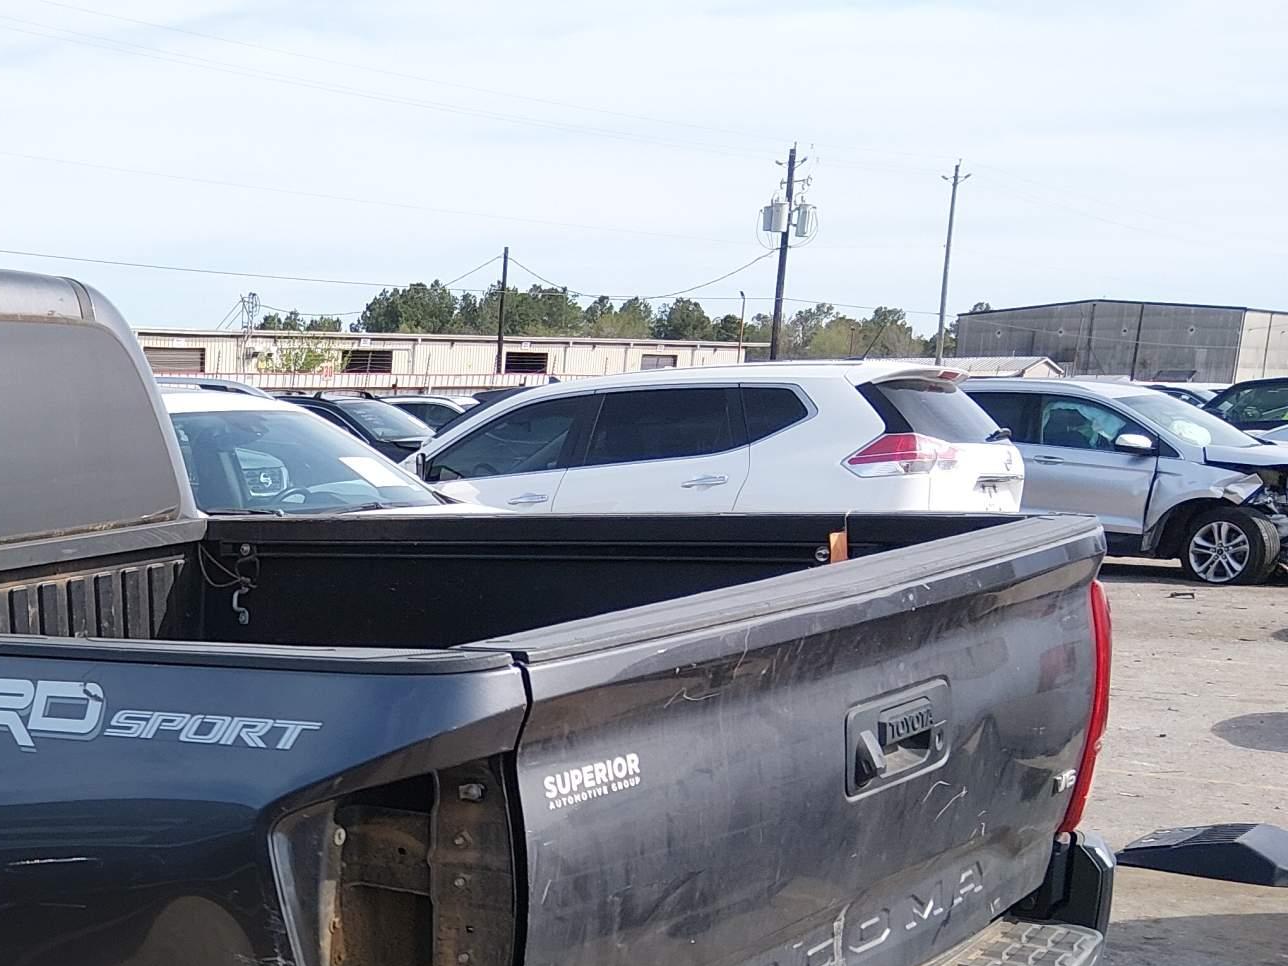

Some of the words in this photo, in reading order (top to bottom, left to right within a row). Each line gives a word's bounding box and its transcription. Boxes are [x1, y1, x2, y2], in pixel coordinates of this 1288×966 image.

[104, 709, 323, 751] SPORT
[888, 708, 934, 740] TOYOTA
[544, 753, 641, 799] SUPERIOR
[549, 785, 609, 810] AUTOMOTIVE
[611, 775, 641, 792] GROUP
